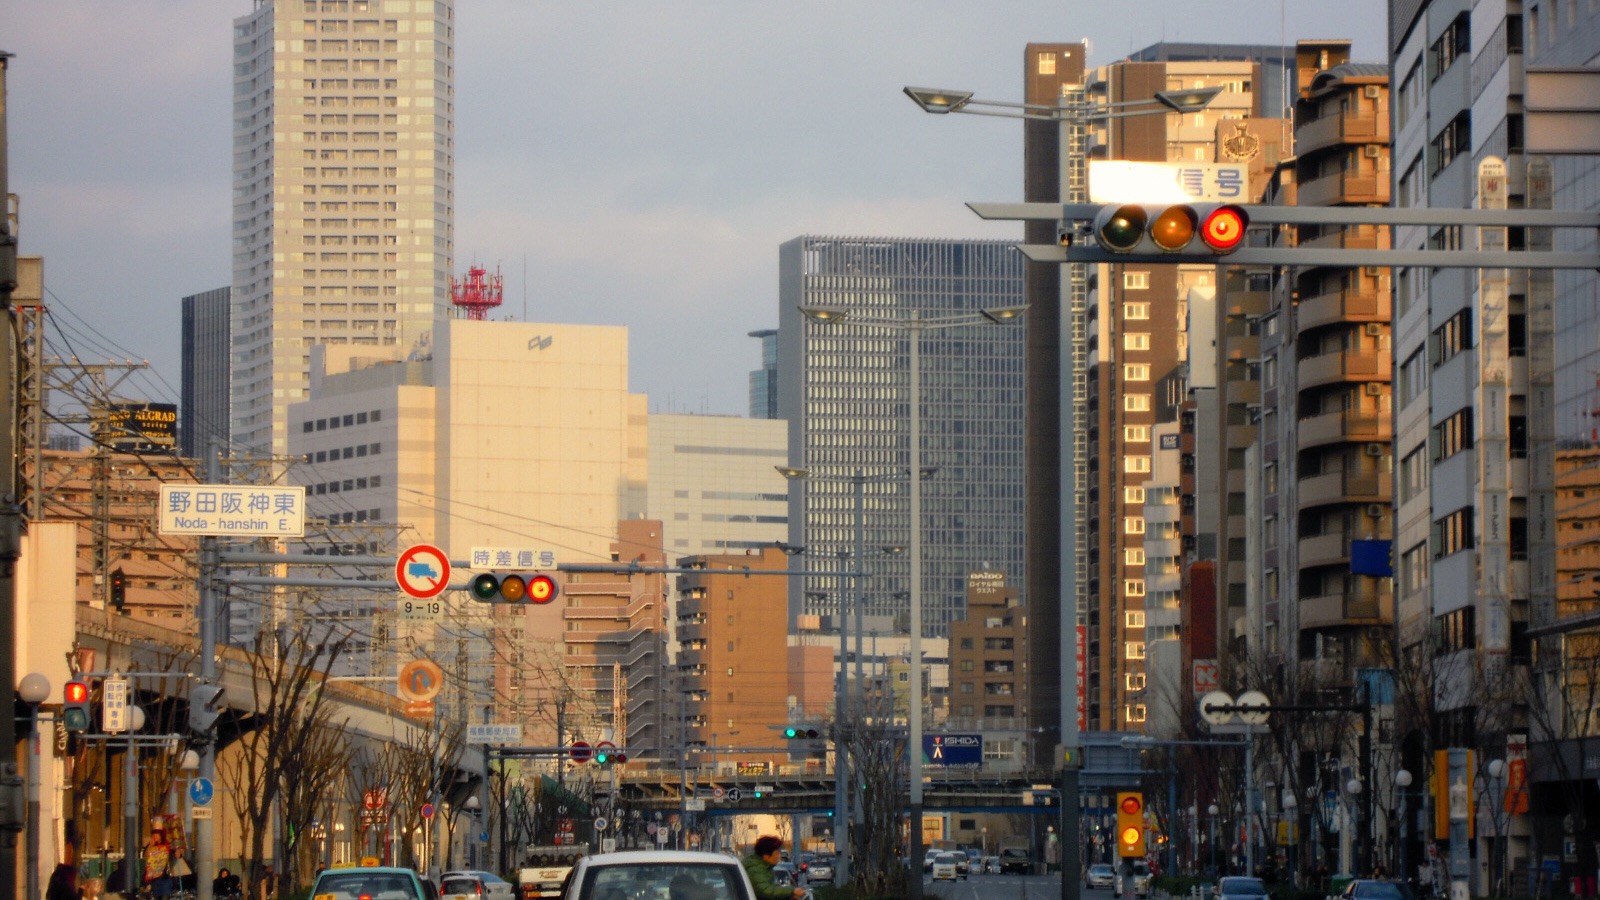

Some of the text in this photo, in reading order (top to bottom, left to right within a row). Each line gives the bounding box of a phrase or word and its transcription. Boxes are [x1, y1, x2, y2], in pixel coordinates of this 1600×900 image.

[169, 491, 296, 515] 野田阪神東
[278, 518, 292, 531] E.
[473, 550, 555, 567] 時差信号
[944, 736, 979, 745] ISHIDA
